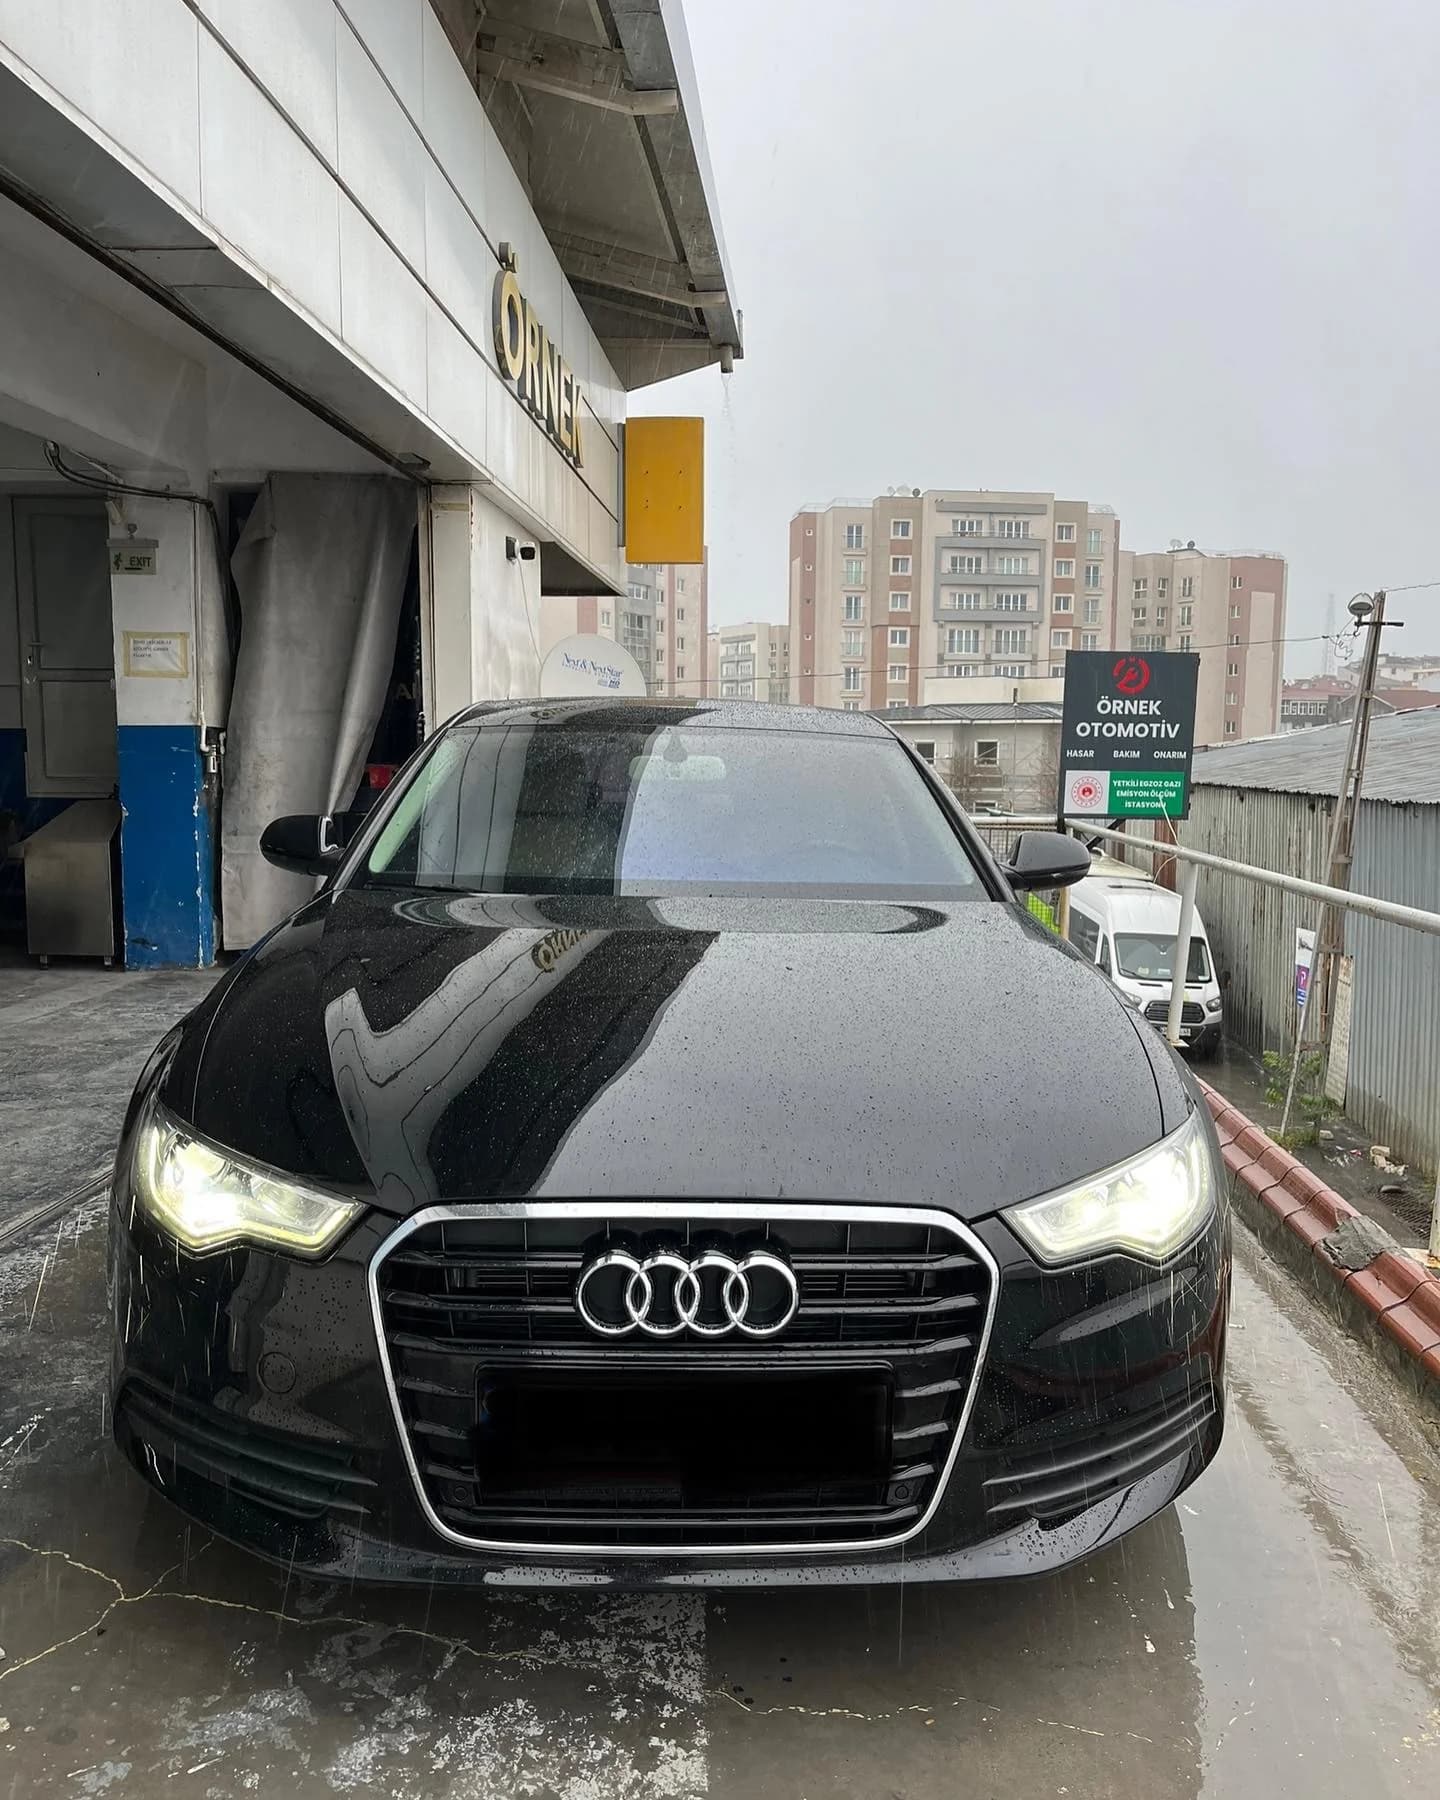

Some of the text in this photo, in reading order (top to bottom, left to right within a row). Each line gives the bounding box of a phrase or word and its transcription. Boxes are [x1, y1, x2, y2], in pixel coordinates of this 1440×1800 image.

[492, 242, 583, 468] ÖRNEK
[129, 556, 152, 567] EXIT
[1097, 695, 1162, 715] ÖRNEK
[1076, 719, 1180, 738] OTOMOTİV
[1066, 749, 1187, 759] HASAR BAKIM ONARIM
[1112, 779, 1139, 787] YETKİLİ
[1163, 780, 1181, 788] GAZI
[1150, 789, 1176, 798] ÖLÇÜM
